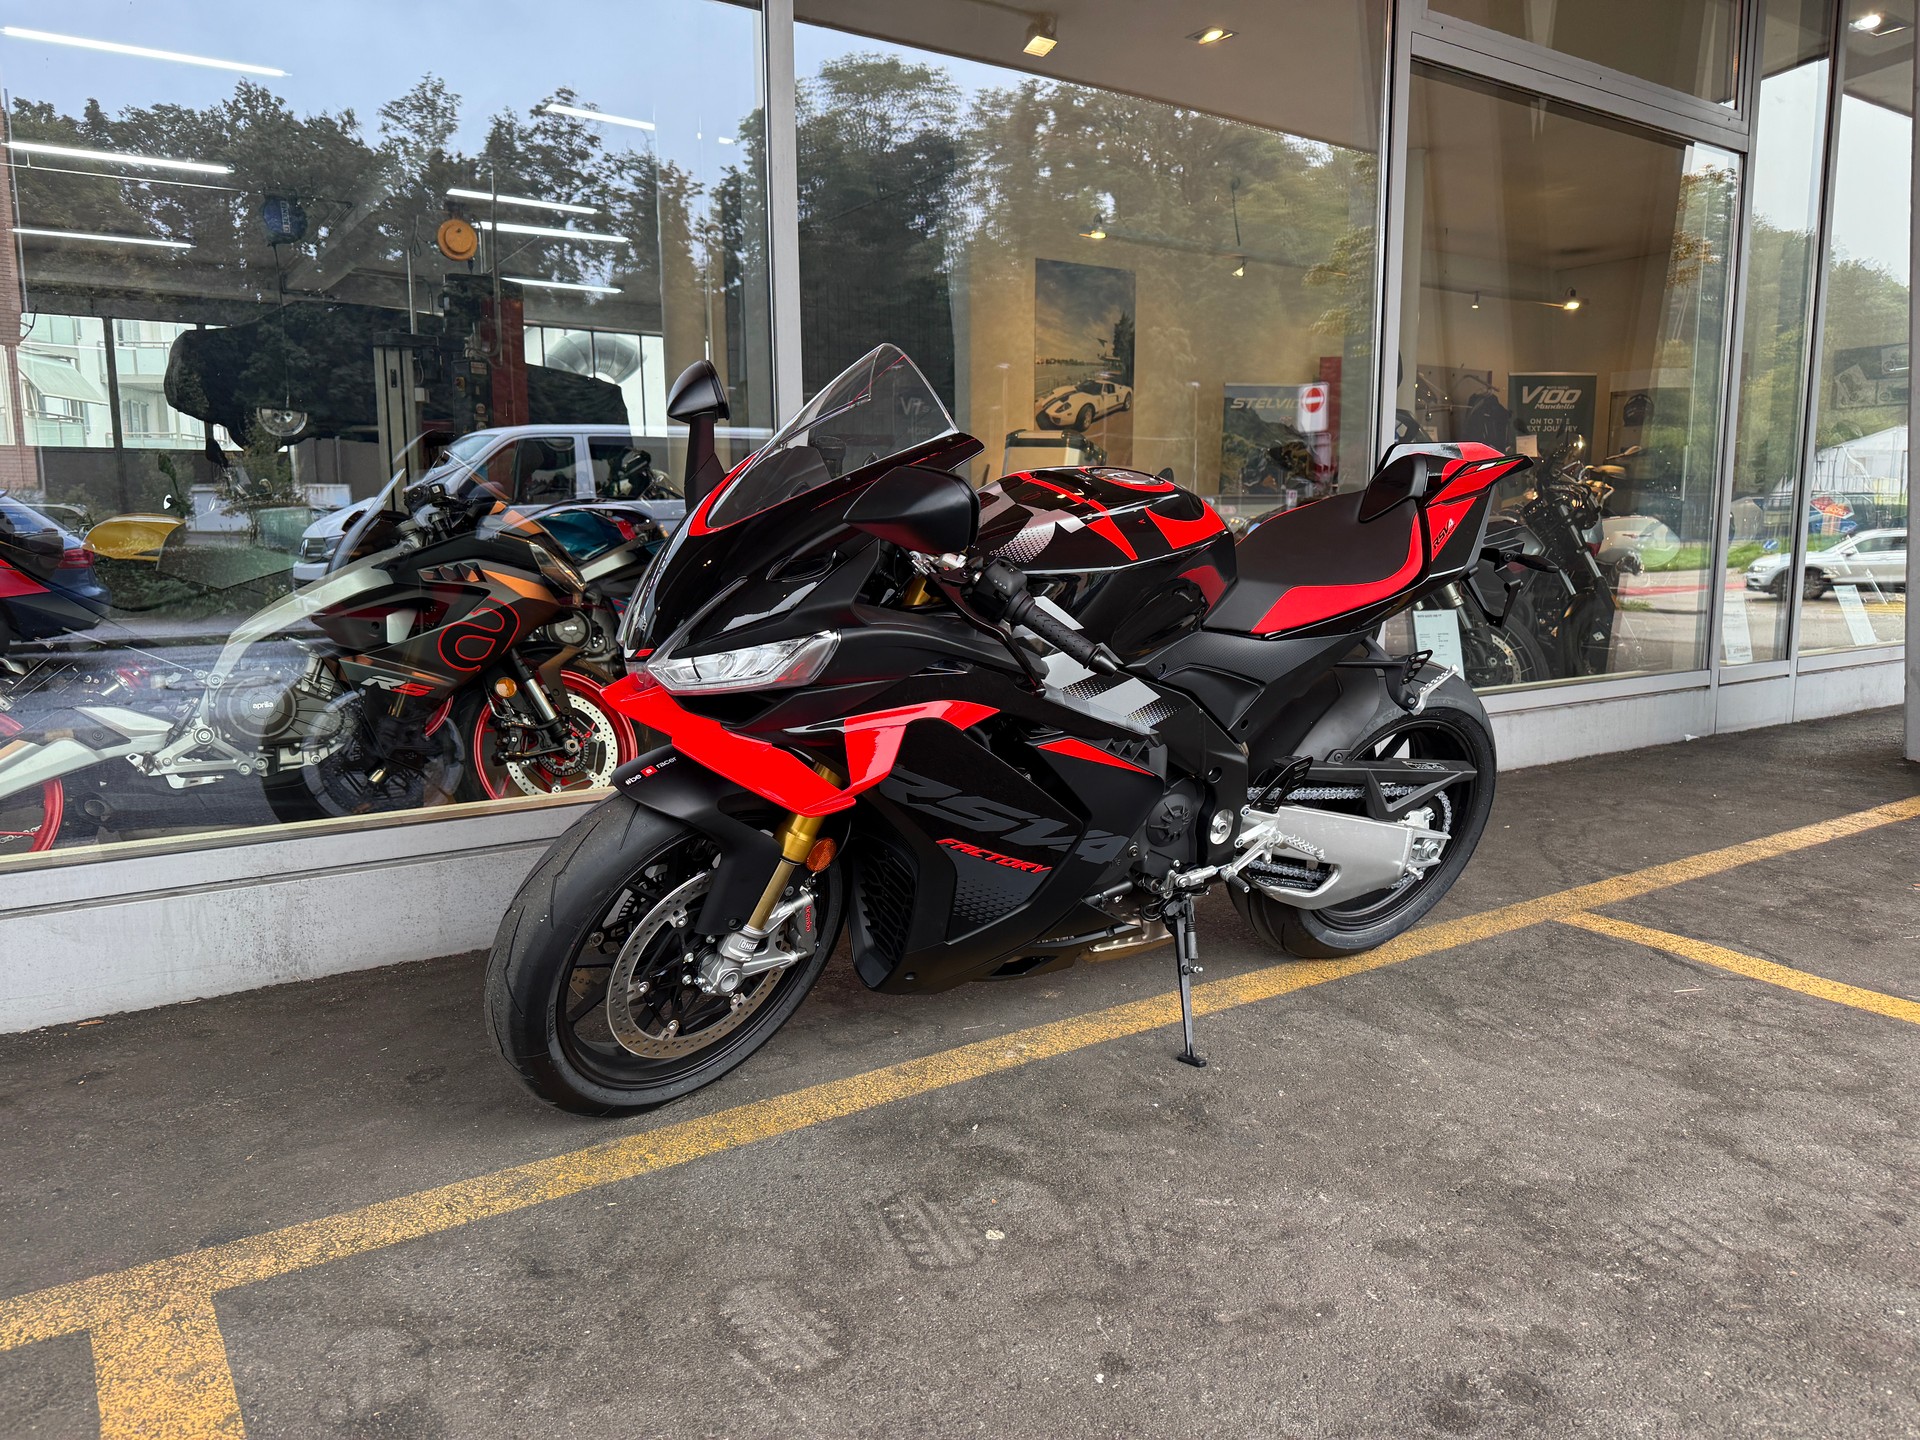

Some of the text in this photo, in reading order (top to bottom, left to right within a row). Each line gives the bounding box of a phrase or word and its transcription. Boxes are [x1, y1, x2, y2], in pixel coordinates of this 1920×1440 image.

[1522, 386, 1581, 404] V100
[360, 675, 436, 697] RS
[252, 701, 274, 710] aprilia
[656, 757, 677, 768] racer
[879, 763, 1130, 865] RSV4
[935, 837, 1053, 874] FACTORY
